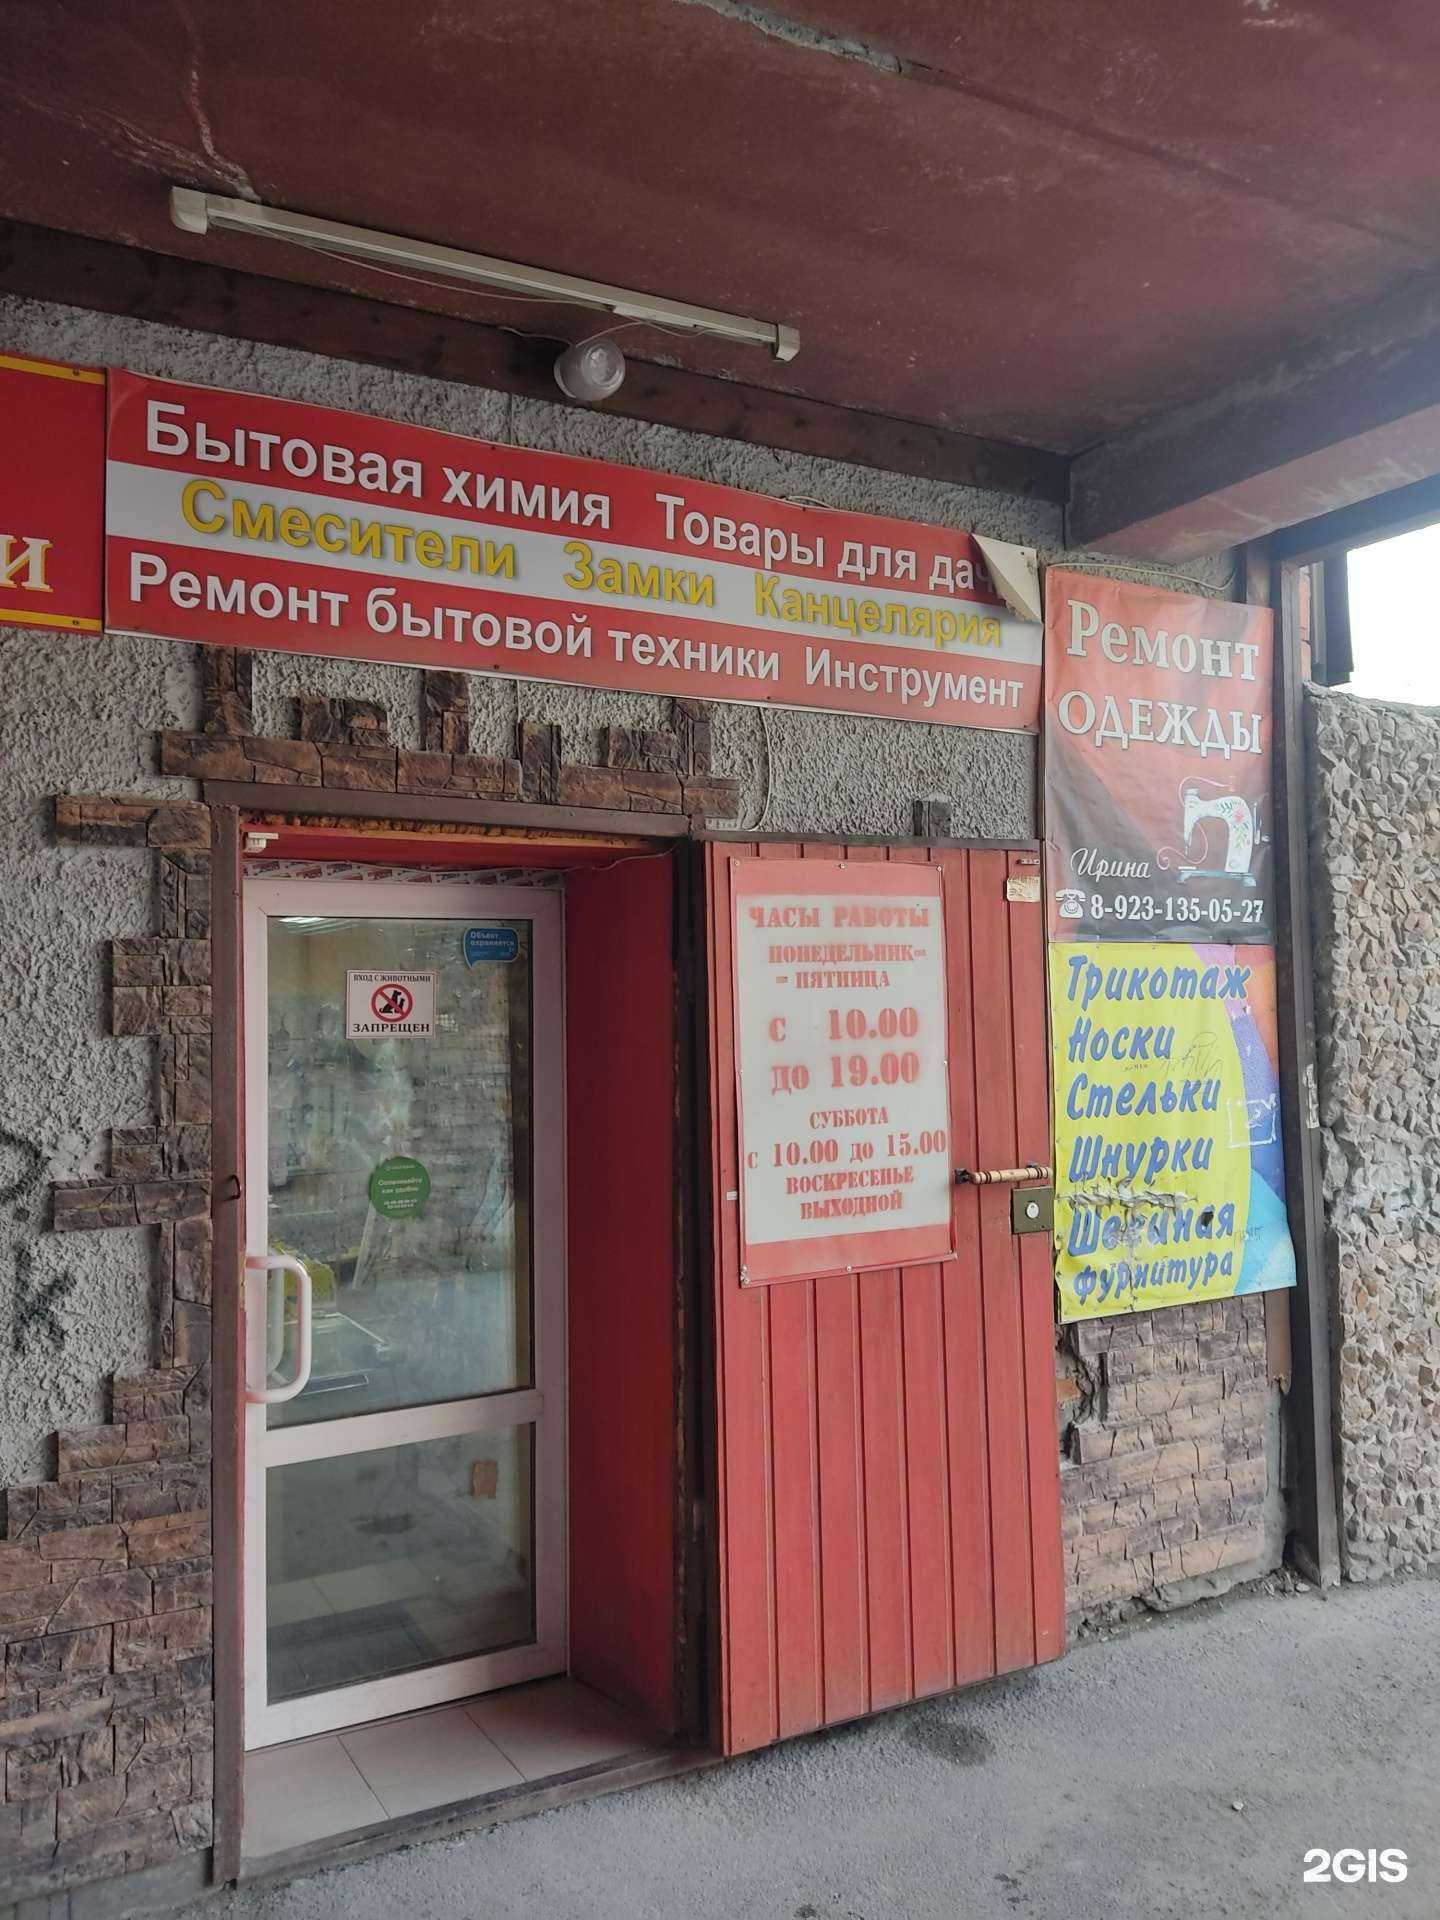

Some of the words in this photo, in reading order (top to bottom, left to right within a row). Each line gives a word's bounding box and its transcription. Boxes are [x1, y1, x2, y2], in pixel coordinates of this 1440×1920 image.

[146, 400, 423, 499] Бытовая
[441, 466, 611, 530] химия
[656, 493, 824, 569] Товары
[837, 539, 917, 581] для
[181, 479, 517, 580] Смесители
[562, 540, 715, 609] Замки
[753, 572, 1002, 650] Канцелярия
[129, 551, 349, 628] Ремонт
[365, 586, 593, 659] бытовой
[607, 627, 781, 682] техники
[805, 646, 1024, 709] Инструмент
[1066, 599, 1260, 682] Ремонт
[1057, 689, 1264, 760] ОДЕЖДЫ
[1069, 847, 1152, 883] Ирина
[748, 906, 821, 929] ЧАСЫ
[833, 906, 931, 929] РАБОТЫ
[1090, 893, 1264, 924] 8-923-135-05-27
[795, 970, 891, 990] ПЯТНИЦА
[1067, 954, 1251, 1012] Трикотаж
[352, 1023, 431, 1035] ЗАПРЕЩЕН
[828, 1006, 919, 1041] 10.00
[1067, 1016, 1176, 1064] Носки
[830, 1051, 921, 1089] 19.00
[1066, 1071, 1222, 1121] Стельки
[809, 1106, 890, 1130] СУББОТА
[772, 1137, 839, 1168] 10.00
[887, 1129, 948, 1158] 15.00
[1068, 1134, 1214, 1186] Шнурки
[786, 1164, 915, 1195] ВОСКРЕСЕНЬЕ
[800, 1189, 904, 1219] ВЫХОДНОЙ
[1073, 1250, 1234, 1306] фурнитура
